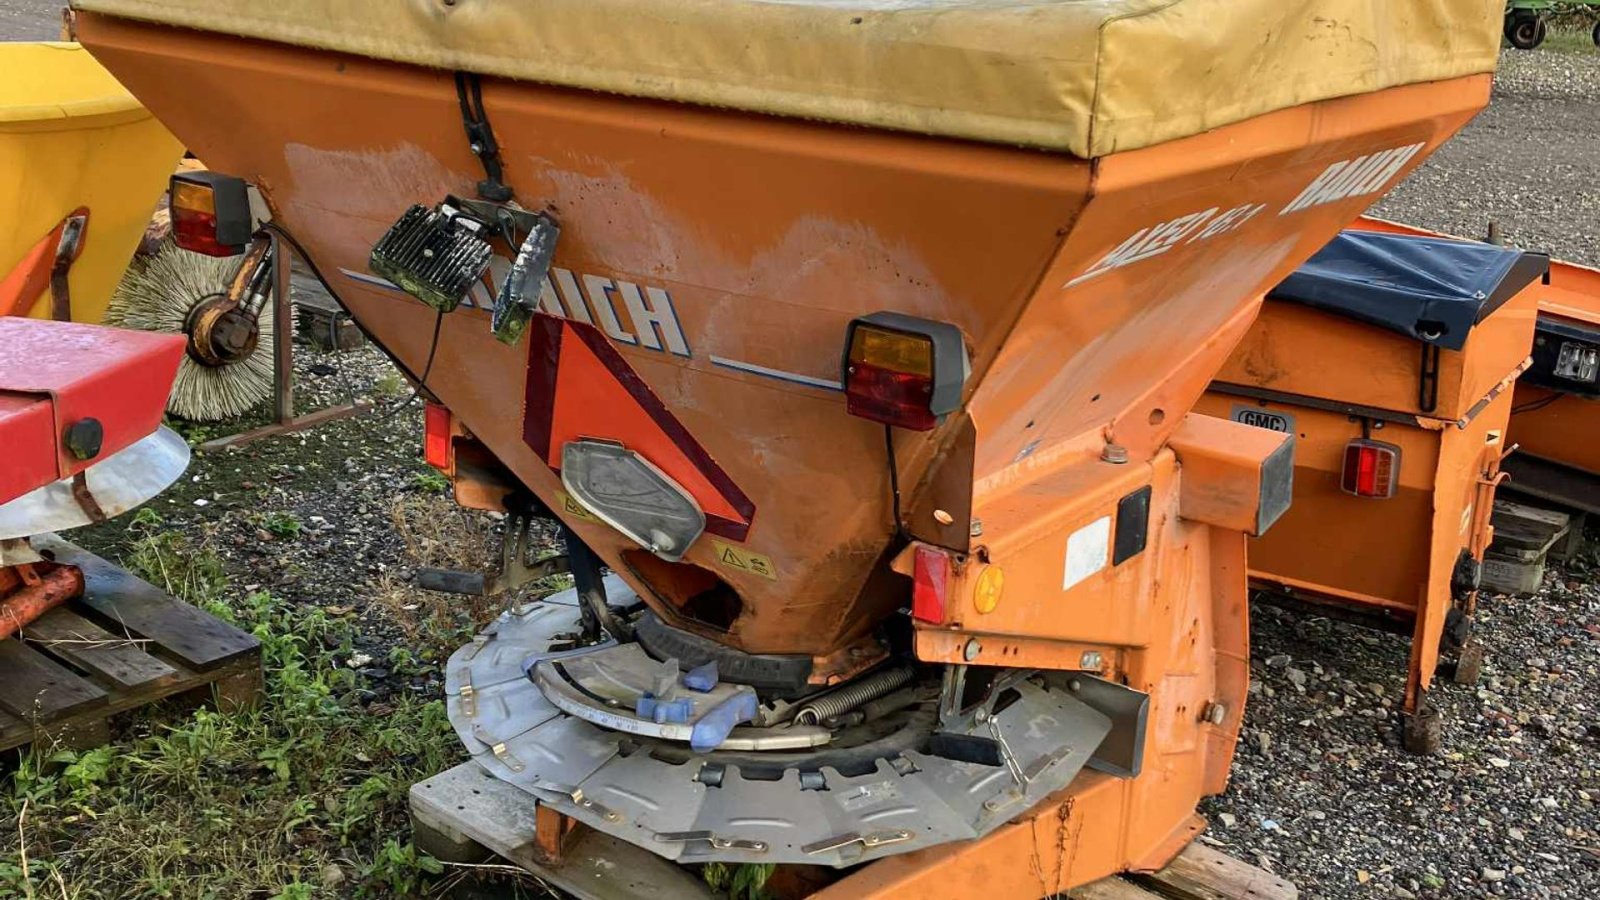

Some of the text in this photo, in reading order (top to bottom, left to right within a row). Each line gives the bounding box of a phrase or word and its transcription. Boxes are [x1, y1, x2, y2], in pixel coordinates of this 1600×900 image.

[1279, 141, 1426, 216] RAUCH
[1073, 207, 1220, 278] AXEO
[1244, 412, 1280, 431] GMC
